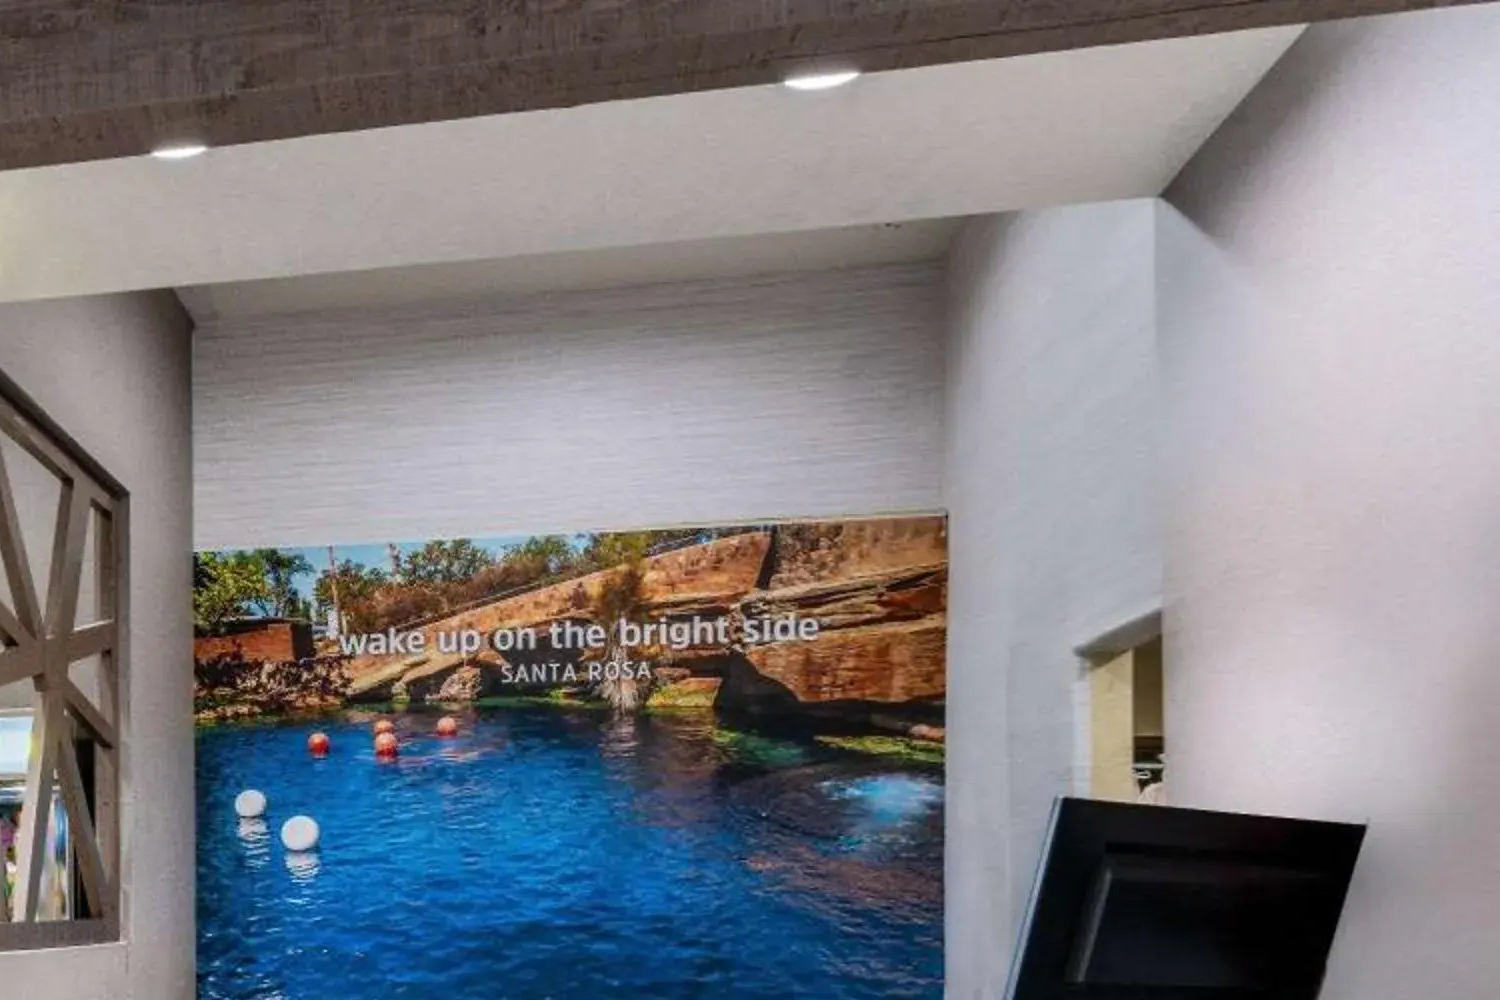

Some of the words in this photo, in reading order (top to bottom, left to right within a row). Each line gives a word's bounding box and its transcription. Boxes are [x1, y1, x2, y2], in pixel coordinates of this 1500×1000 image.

[340, 627, 425, 656] wake
[439, 628, 480, 661] up
[494, 627, 536, 651] on
[550, 620, 606, 648] the
[619, 615, 730, 649] bright
[743, 613, 819, 642] side
[501, 662, 577, 683] SANTA
[589, 660, 651, 681] ROSA
